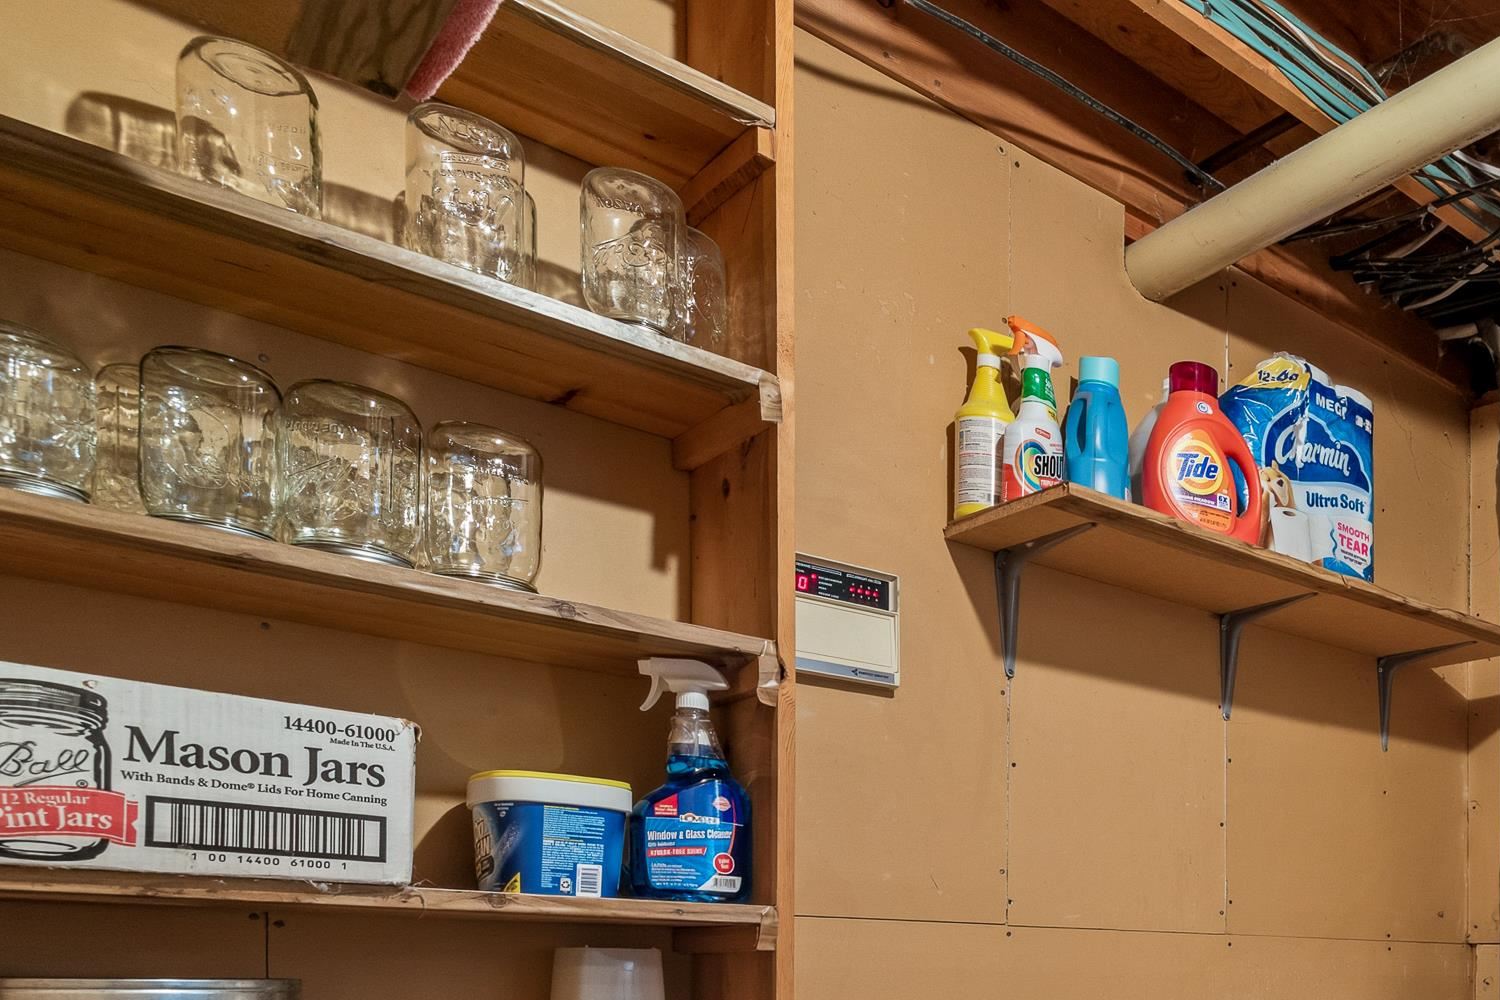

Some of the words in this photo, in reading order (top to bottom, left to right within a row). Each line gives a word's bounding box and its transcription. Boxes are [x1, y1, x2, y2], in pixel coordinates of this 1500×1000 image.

[1177, 453, 1218, 480] Tide
[1306, 491, 1338, 507] Ultra
[1340, 494, 1364, 514] Soft
[1337, 522, 1369, 542] SMOOTH
[1339, 534, 1368, 556] TEAR
[284, 716, 395, 742] 14400-61000
[330, 738, 349, 746] Made
[375, 743, 395, 751] U.S.A.
[0, 741, 90, 786] Ball
[122, 725, 293, 778] Mason
[303, 746, 386, 788] Jars
[2, 794, 20, 804] 12
[24, 792, 90, 806] Regular
[120, 770, 153, 782] With
[156, 773, 195, 786] Bands
[197, 777, 208, 788] &
[257, 783, 282, 795] Lids
[284, 786, 305, 797] For
[306, 788, 340, 800] Home
[342, 792, 388, 807] Canning
[56, 806, 112, 830] Jars
[647, 830, 677, 840] Window
[686, 830, 705, 838] Glass
[707, 829, 732, 838] Cleaner
[238, 855, 280, 866] 14400
[290, 860, 331, 869] 61000
